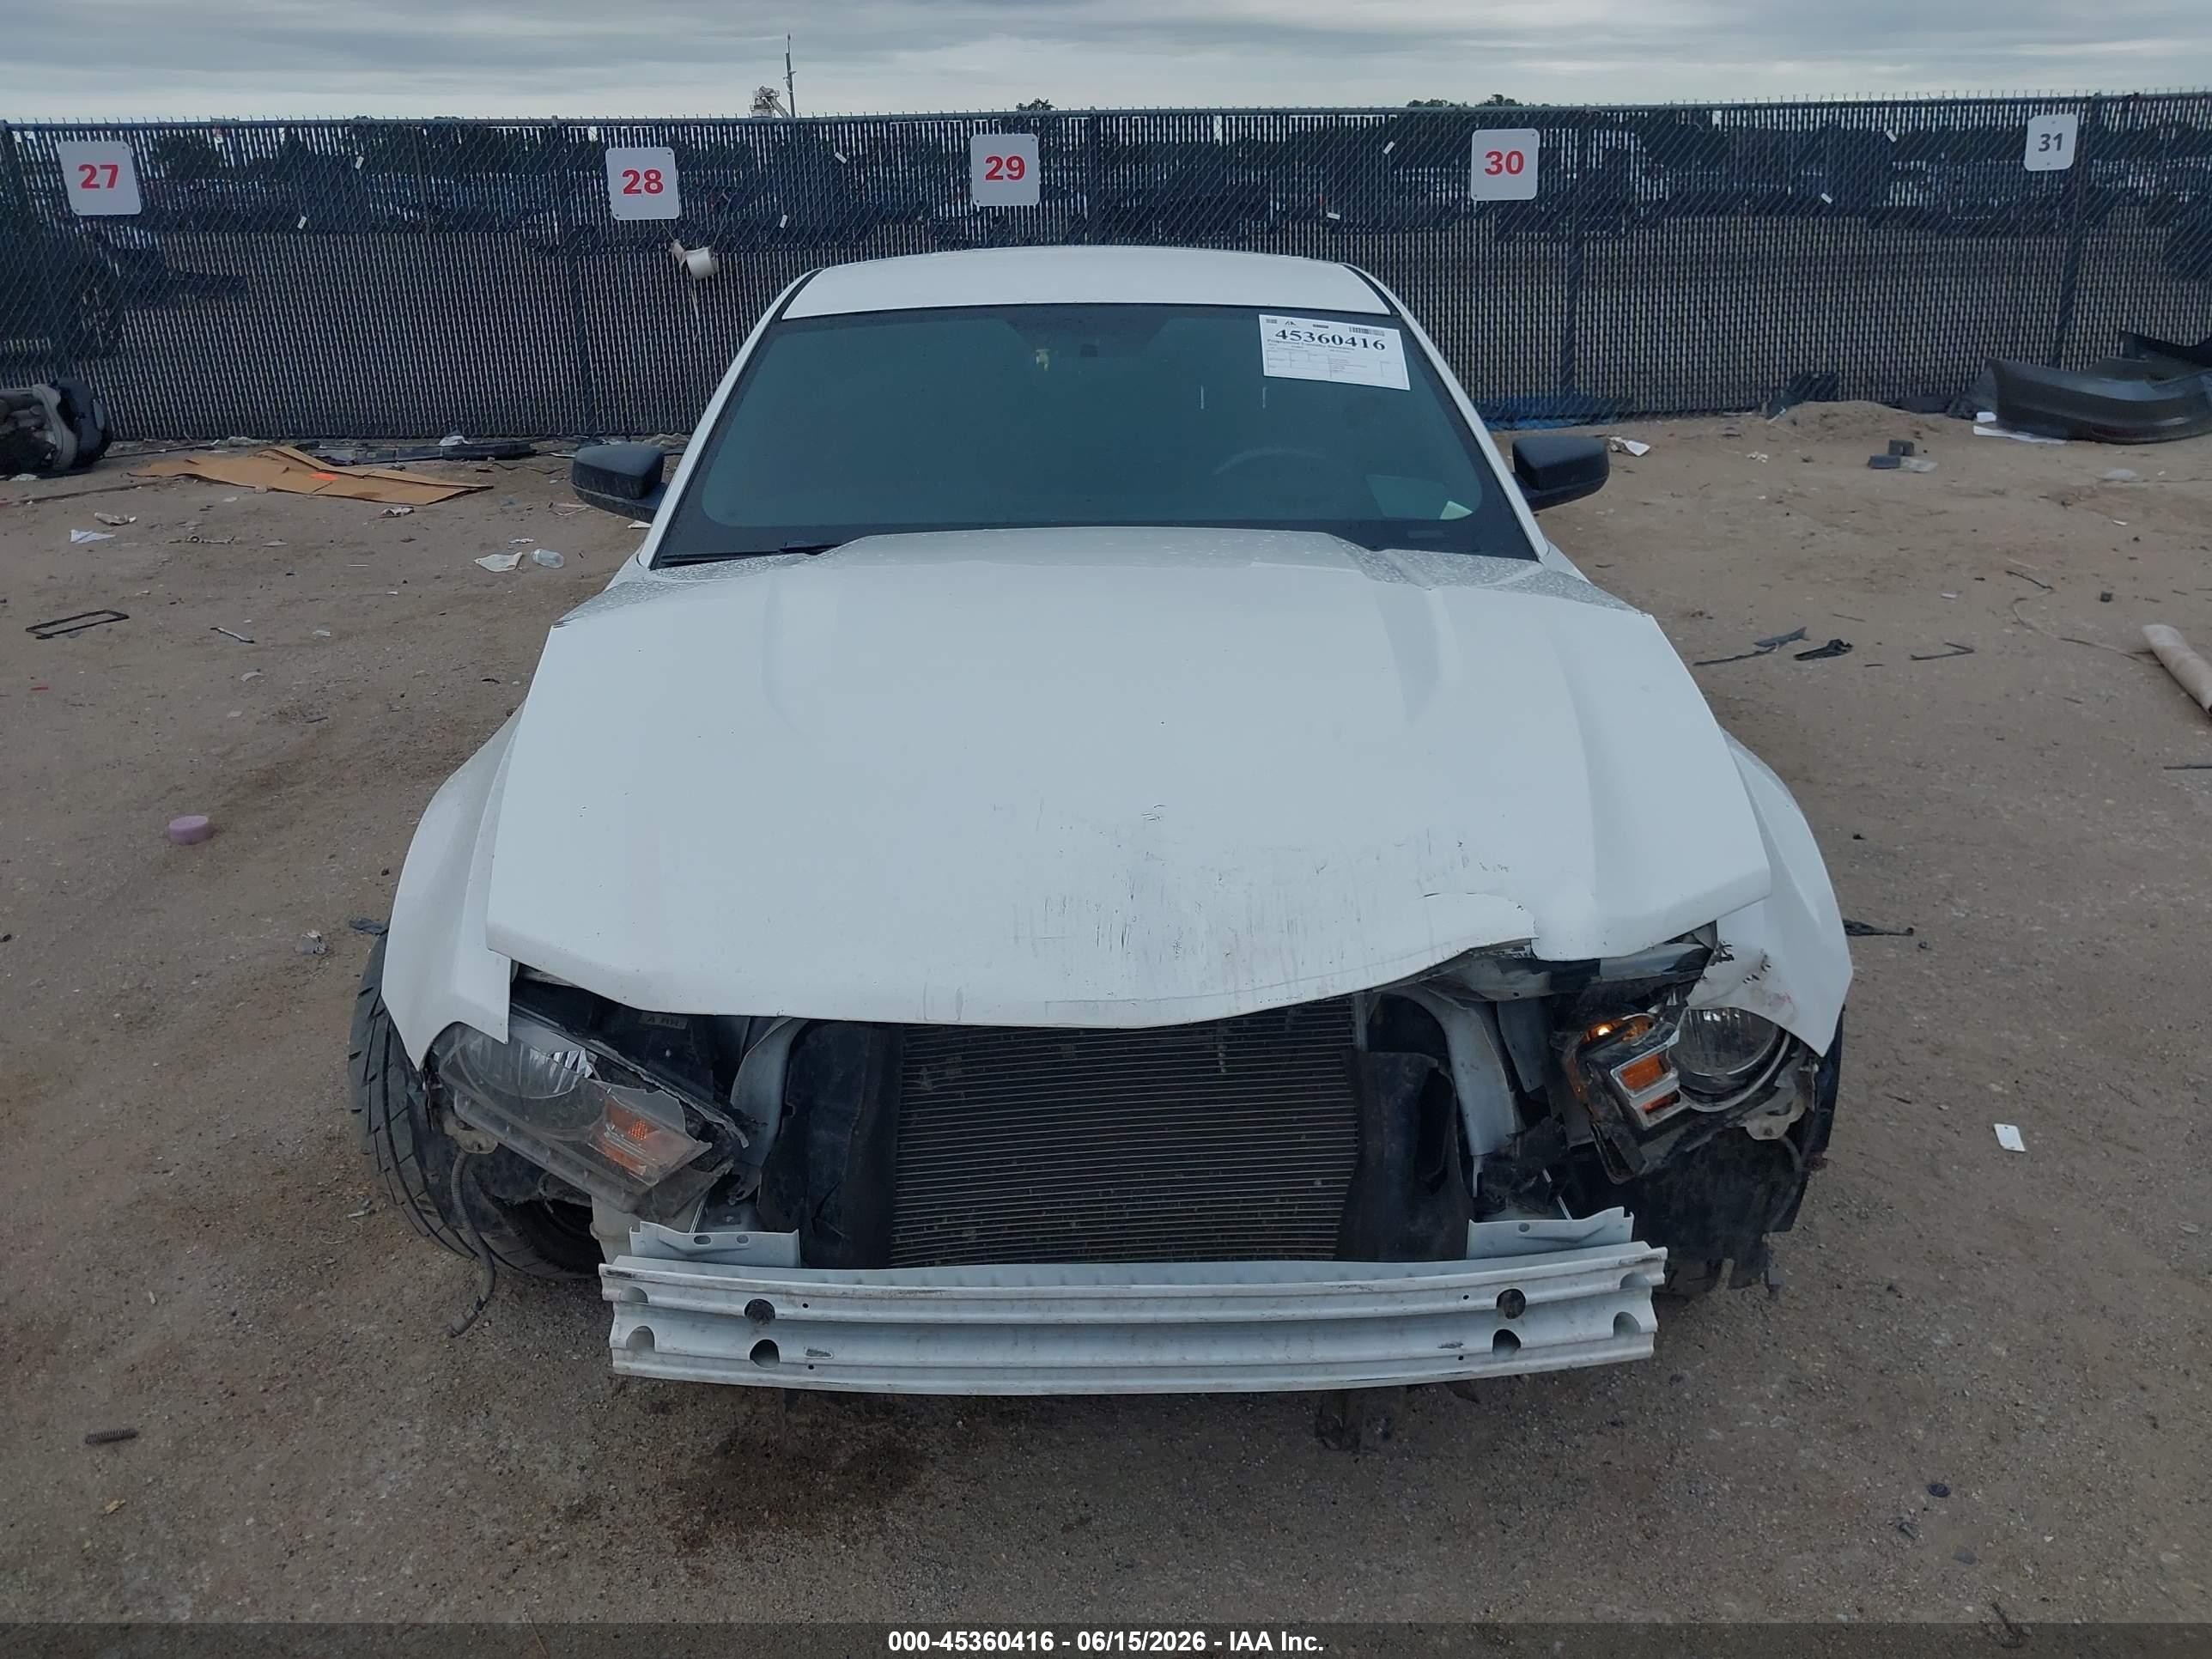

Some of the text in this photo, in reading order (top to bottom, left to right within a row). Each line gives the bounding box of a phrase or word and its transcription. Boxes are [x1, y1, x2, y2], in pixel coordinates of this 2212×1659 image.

[2038, 132, 2063, 153] 31
[985, 155, 1024, 180] 29
[1485, 150, 1524, 175] 30
[78, 164, 118, 190] 27
[623, 169, 664, 196] 28
[1275, 329, 1386, 351] 45360416
